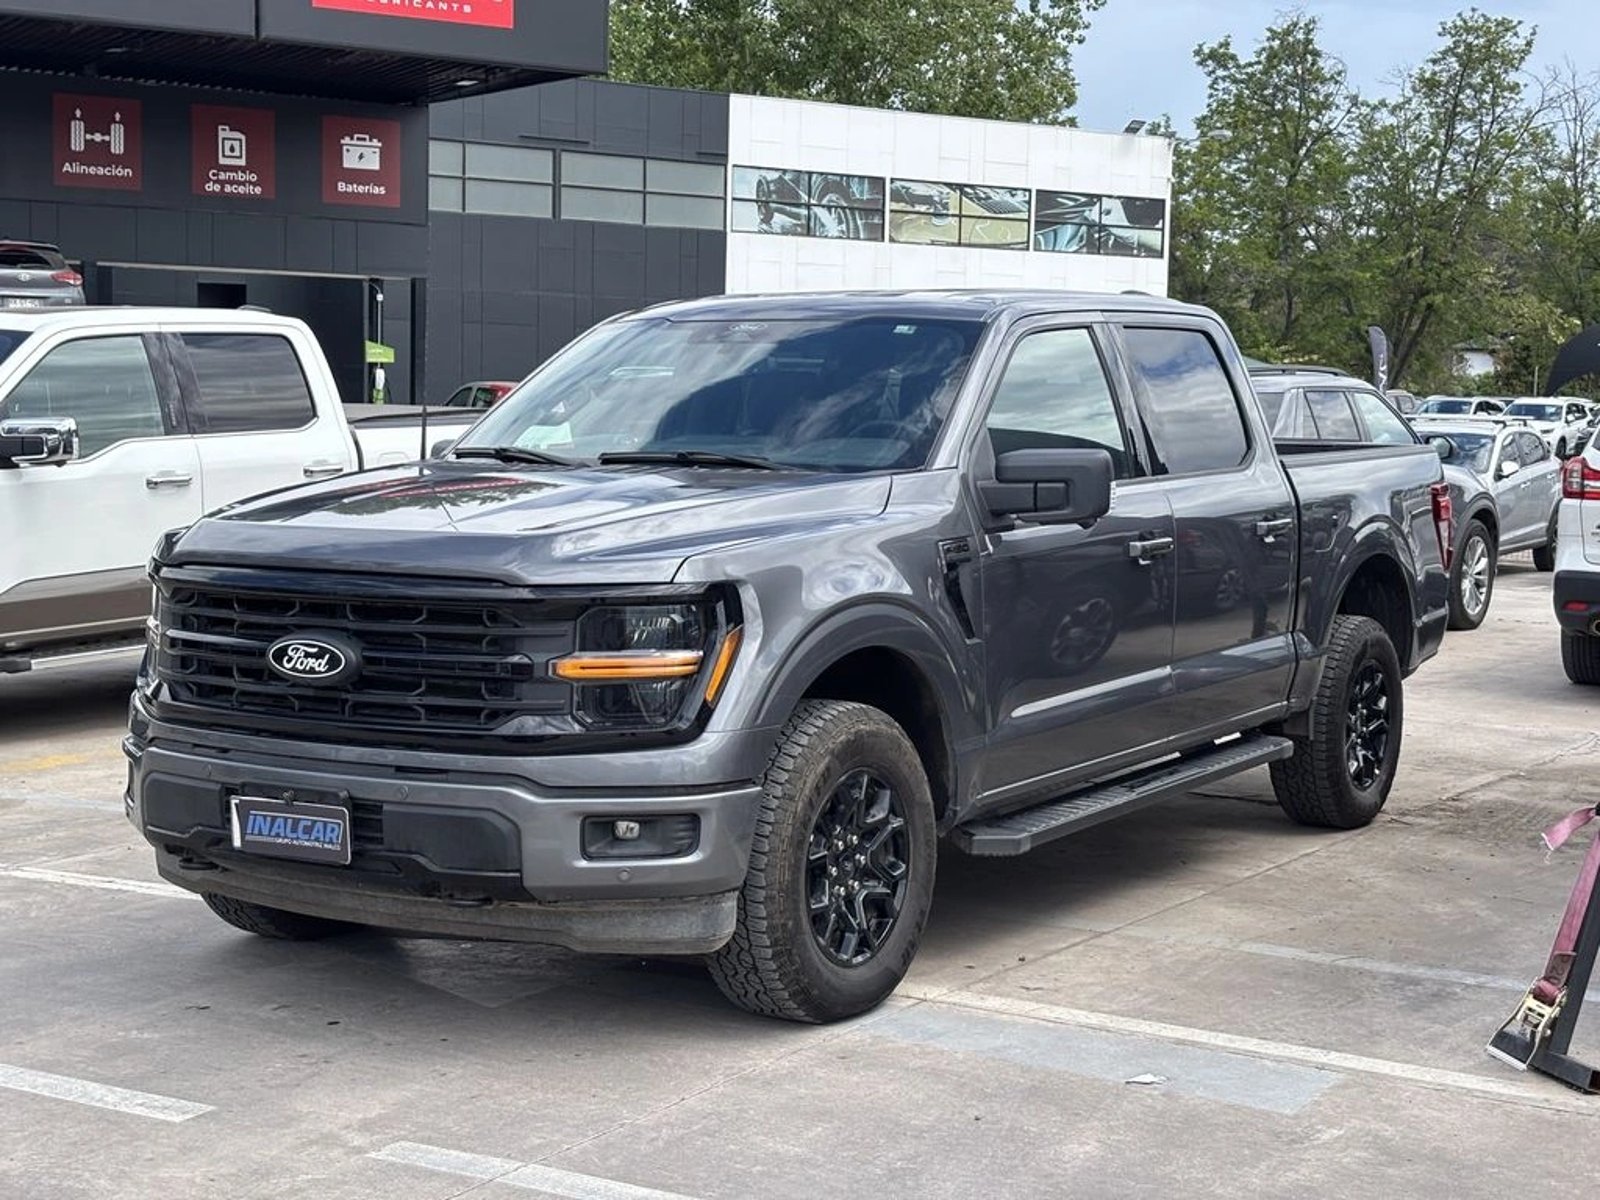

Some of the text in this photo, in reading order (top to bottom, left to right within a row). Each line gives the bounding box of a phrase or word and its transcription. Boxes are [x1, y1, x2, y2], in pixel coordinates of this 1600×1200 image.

[62, 162, 133, 178] Alineación
[208, 169, 257, 182] Cambio
[205, 181, 262, 195] de aceite
[337, 181, 386, 194] Baterías
[283, 644, 330, 672] Ford
[246, 815, 340, 843] INALCAR
